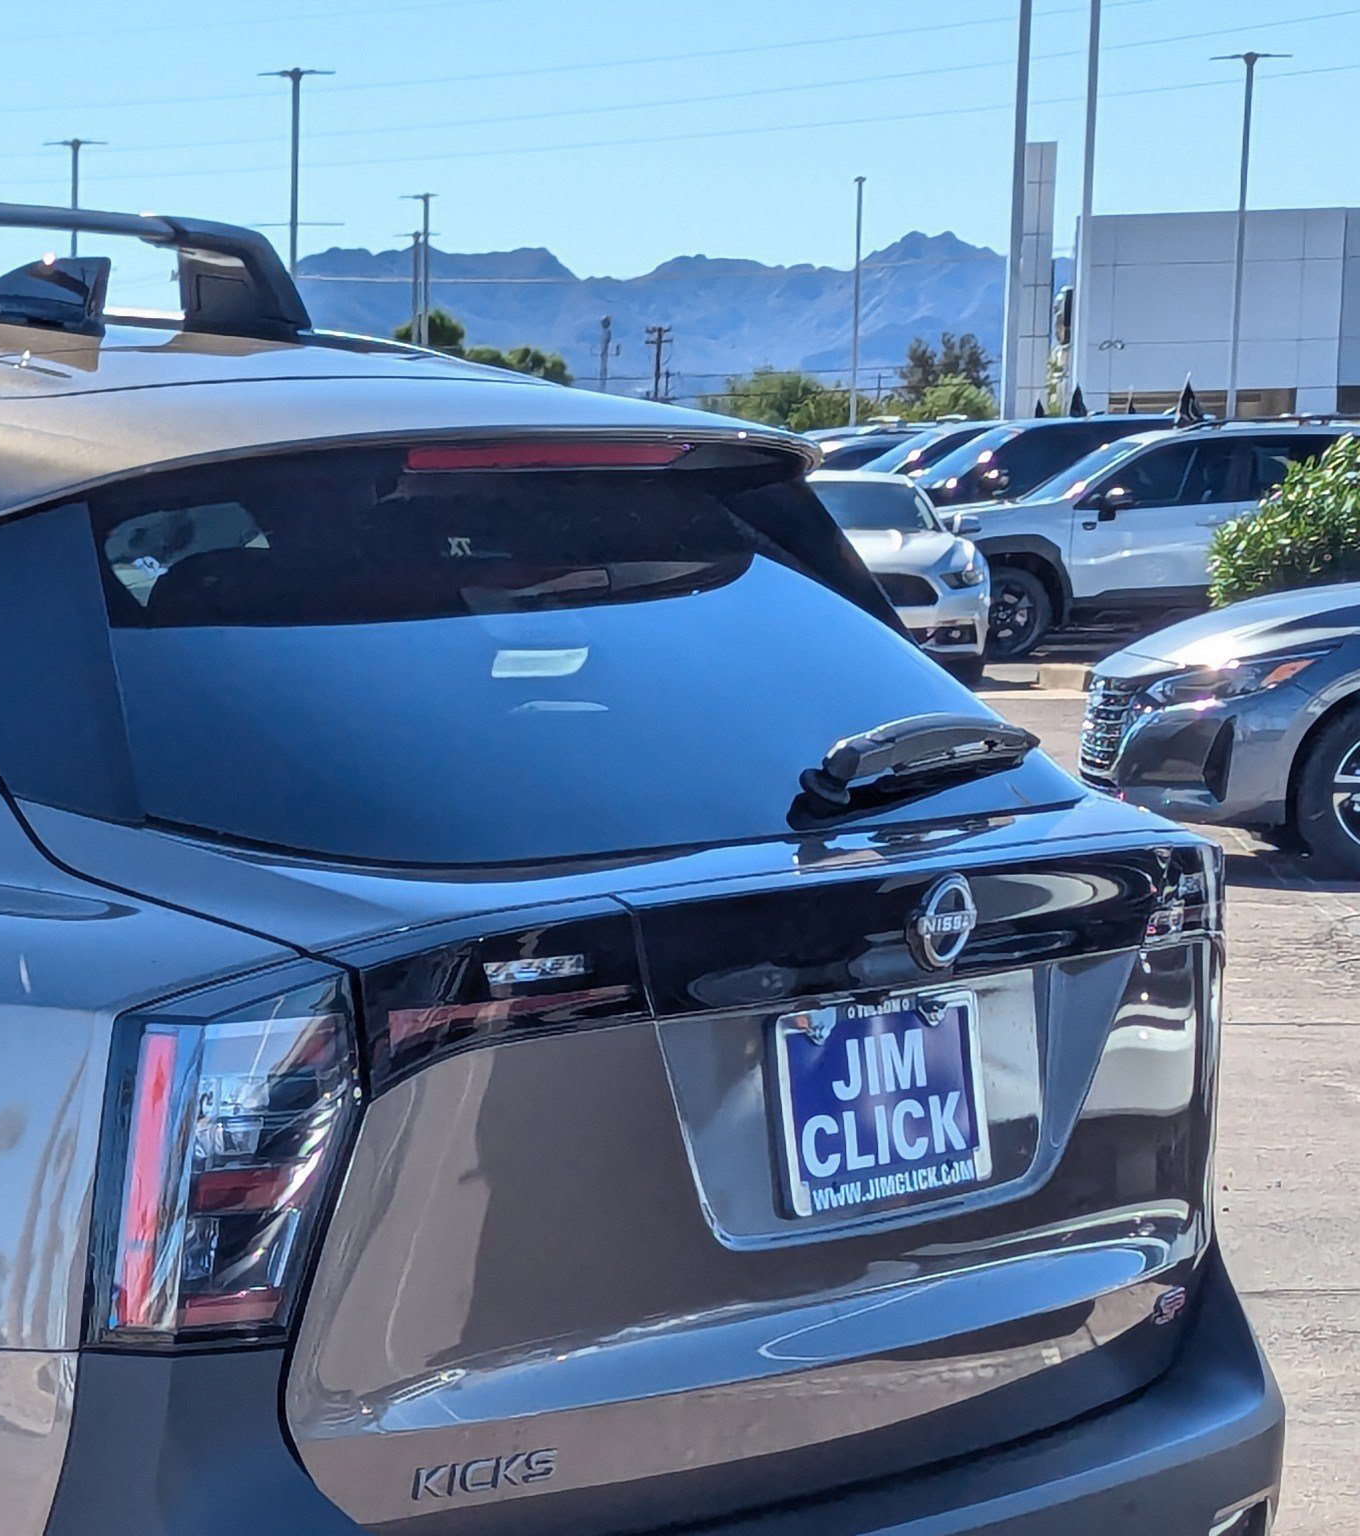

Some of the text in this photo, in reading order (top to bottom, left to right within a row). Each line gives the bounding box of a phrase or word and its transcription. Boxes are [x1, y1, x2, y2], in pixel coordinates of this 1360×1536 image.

[832, 1029, 927, 1100] JIM
[801, 1091, 967, 1178] CLICK
[812, 1159, 974, 1211] WWW.JIMCLICK.COM
[411, 1446, 558, 1500] KICKS
